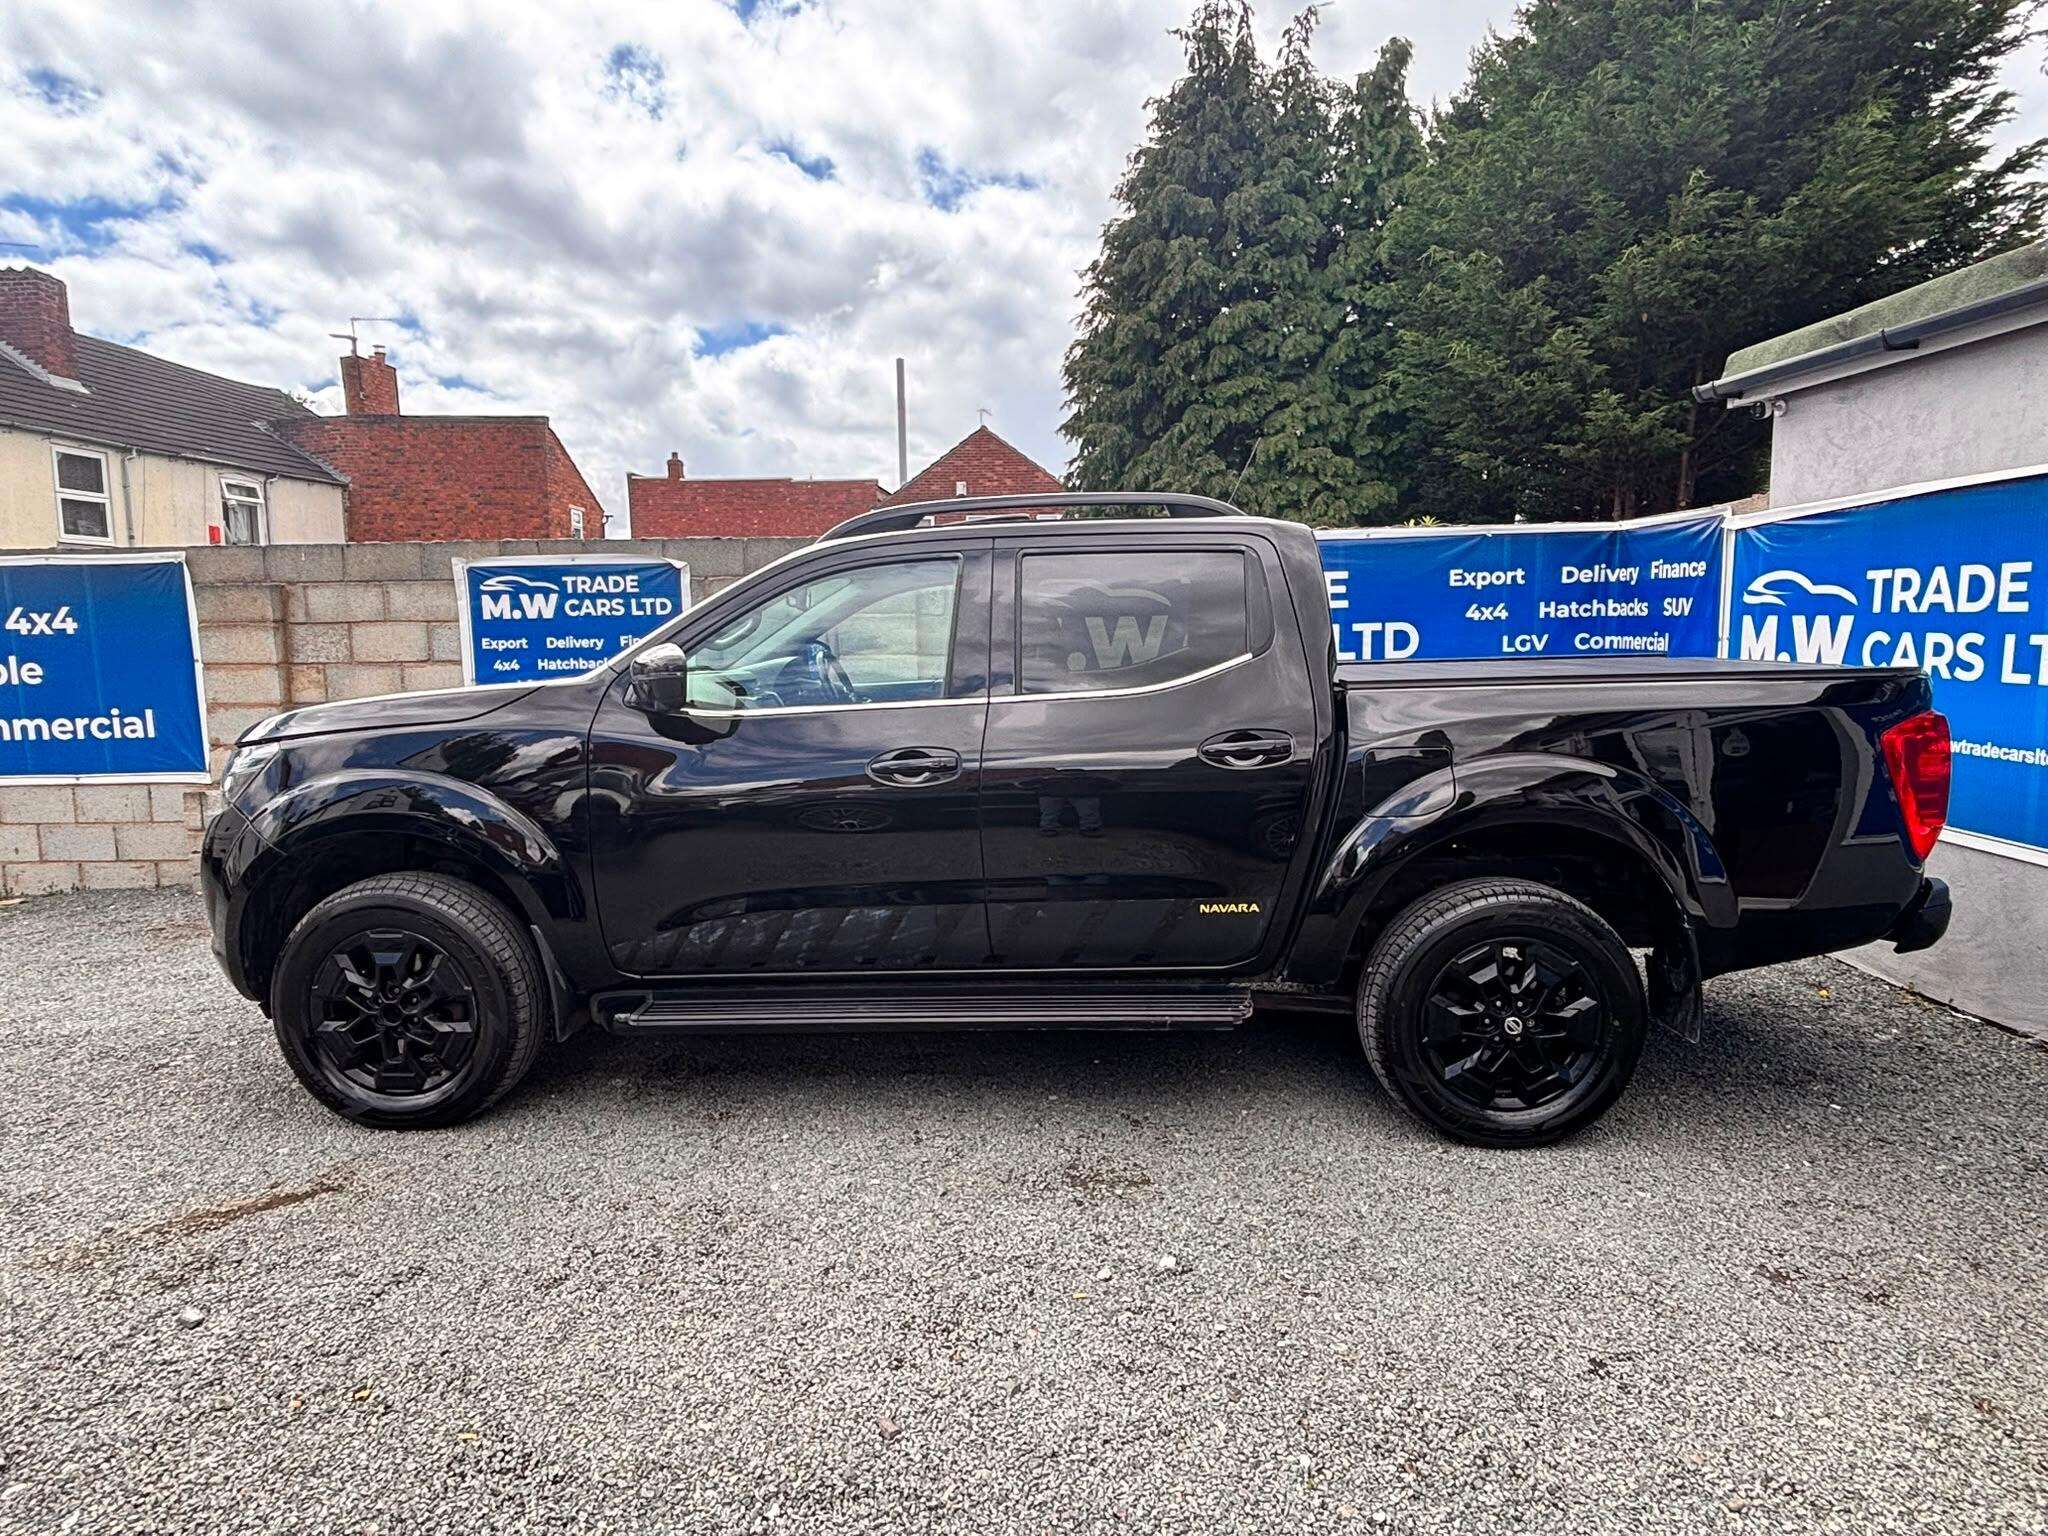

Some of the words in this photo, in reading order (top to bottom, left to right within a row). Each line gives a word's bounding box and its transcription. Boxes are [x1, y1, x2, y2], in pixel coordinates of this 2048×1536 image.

[562, 575, 640, 594] TRADE
[1449, 567, 1525, 590] Export
[1561, 564, 1640, 586] Delivery
[1650, 559, 1707, 580] Finance
[1866, 561, 2033, 614] TRADE
[481, 593, 558, 620] M.W
[564, 598, 626, 617] CARS
[631, 597, 673, 616] LTD
[1465, 602, 1509, 621] 4x4
[1539, 597, 1649, 620] Hatchbacks
[1663, 597, 1693, 617] SUV
[5, 606, 79, 635] 4x4
[481, 637, 529, 650] Export
[546, 635, 604, 651] Delivery
[1332, 621, 1420, 660] LTD
[1502, 634, 1549, 653] LGV
[1574, 632, 1669, 653] Commercial
[1739, 614, 1855, 665] M.W
[493, 659, 521, 671] 4x4
[1862, 630, 1985, 682] CARS
[1200, 903, 1260, 913] NAVARA
